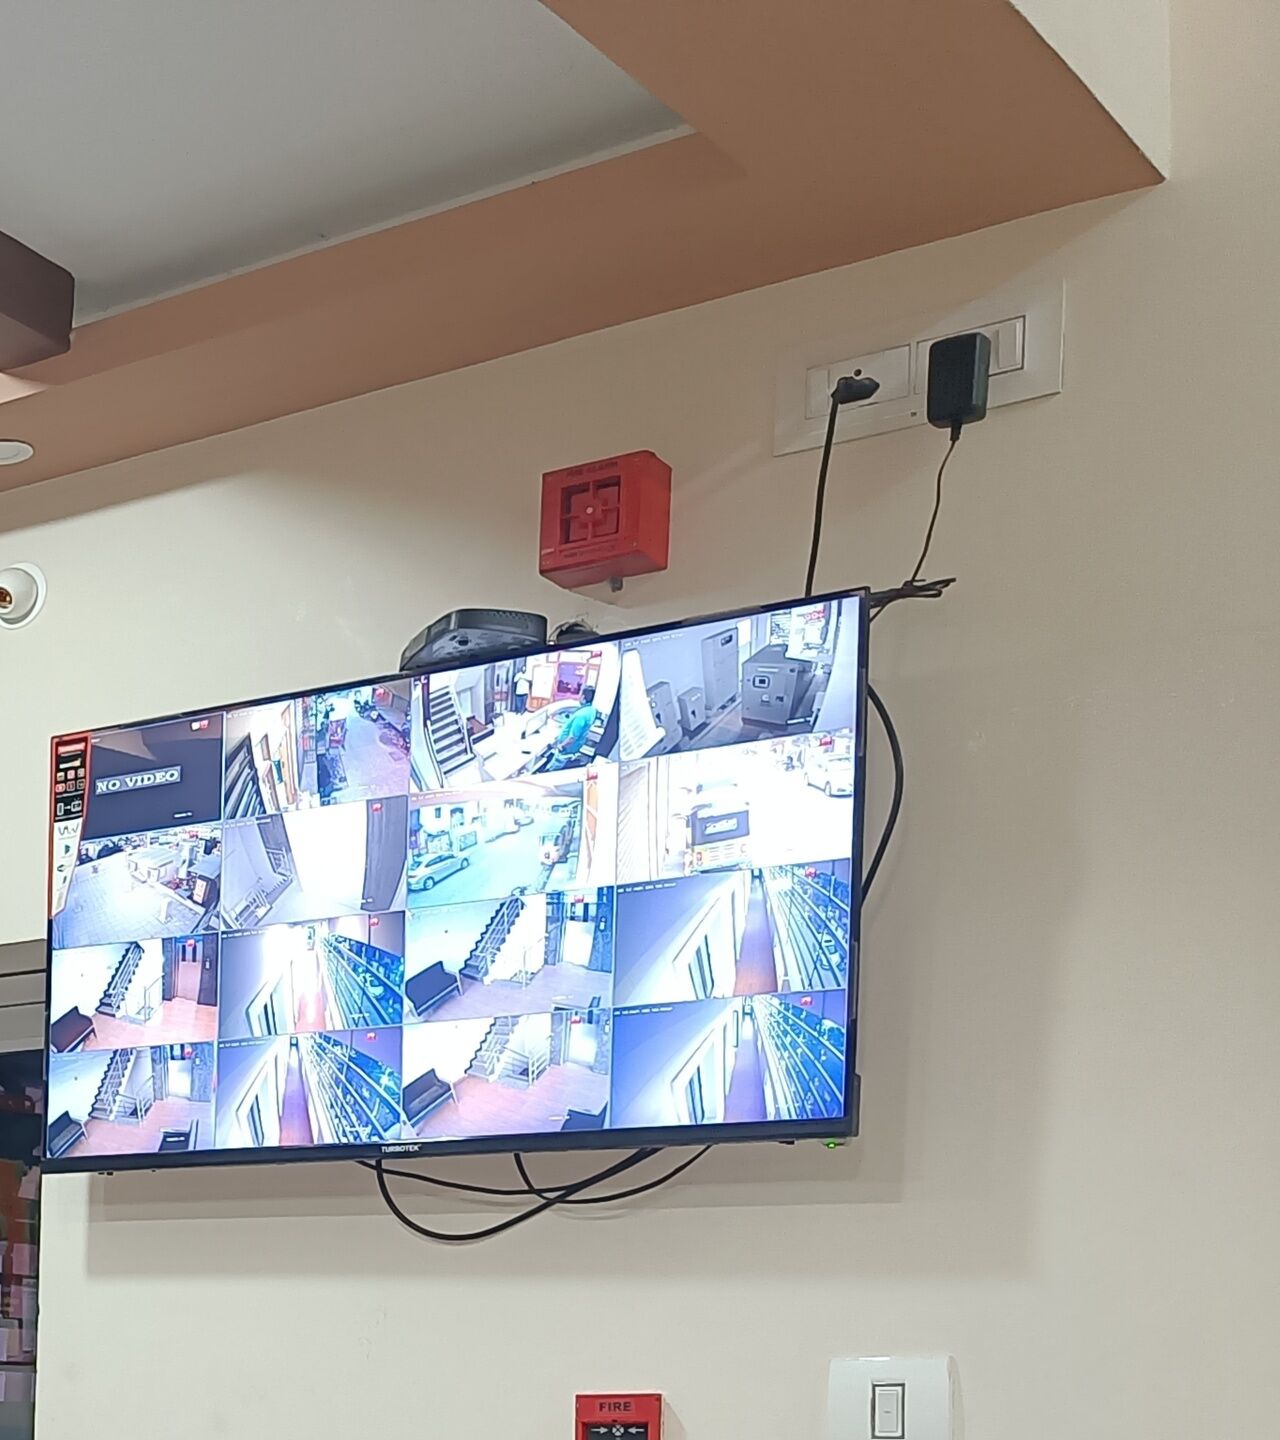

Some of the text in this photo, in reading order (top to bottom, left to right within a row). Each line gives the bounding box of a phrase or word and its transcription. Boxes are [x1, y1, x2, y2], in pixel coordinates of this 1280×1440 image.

[95, 769, 180, 794] NO VIDEO
[599, 1401, 632, 1412] FIRE
